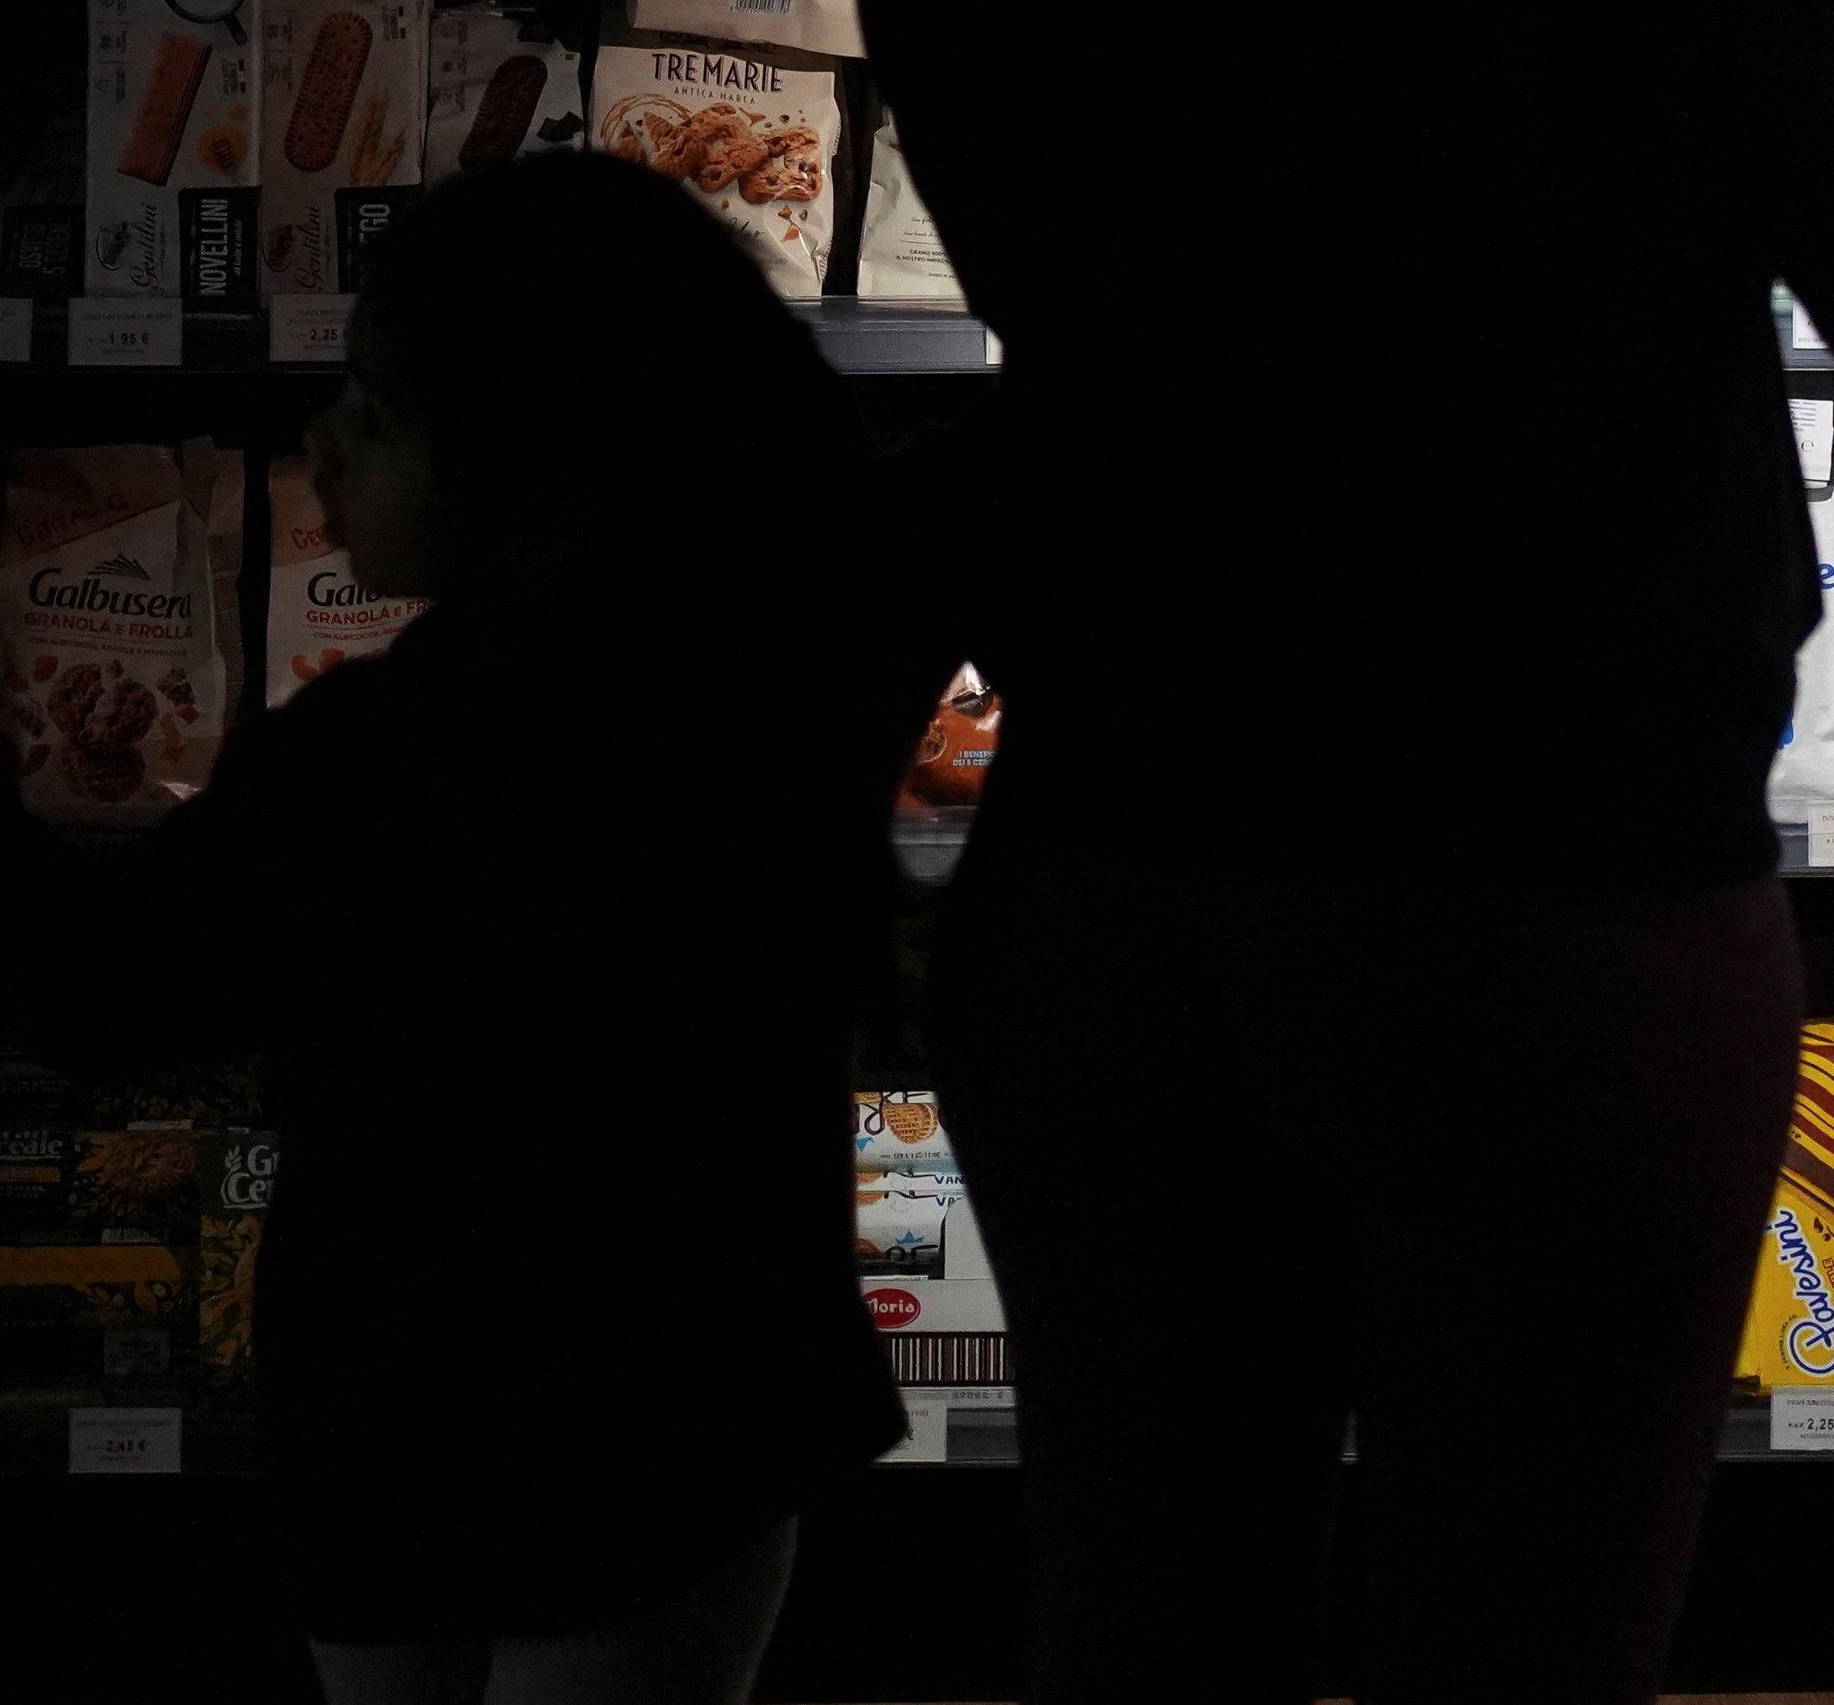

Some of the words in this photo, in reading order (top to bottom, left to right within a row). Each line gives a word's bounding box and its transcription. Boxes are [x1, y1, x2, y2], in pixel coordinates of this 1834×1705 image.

[652, 52, 784, 94] TREMARIE
[673, 86, 715, 100] ANTICA
[720, 92, 755, 105] MARCA
[198, 199, 230, 297] NOVELLINI
[29, 567, 193, 619] Galbusera
[23, 612, 114, 636] GRANOLA
[128, 622, 194, 641] FROLLA
[306, 607, 390, 626] GRANOLA
[1807, 1419, 1834, 1431] 2,25
